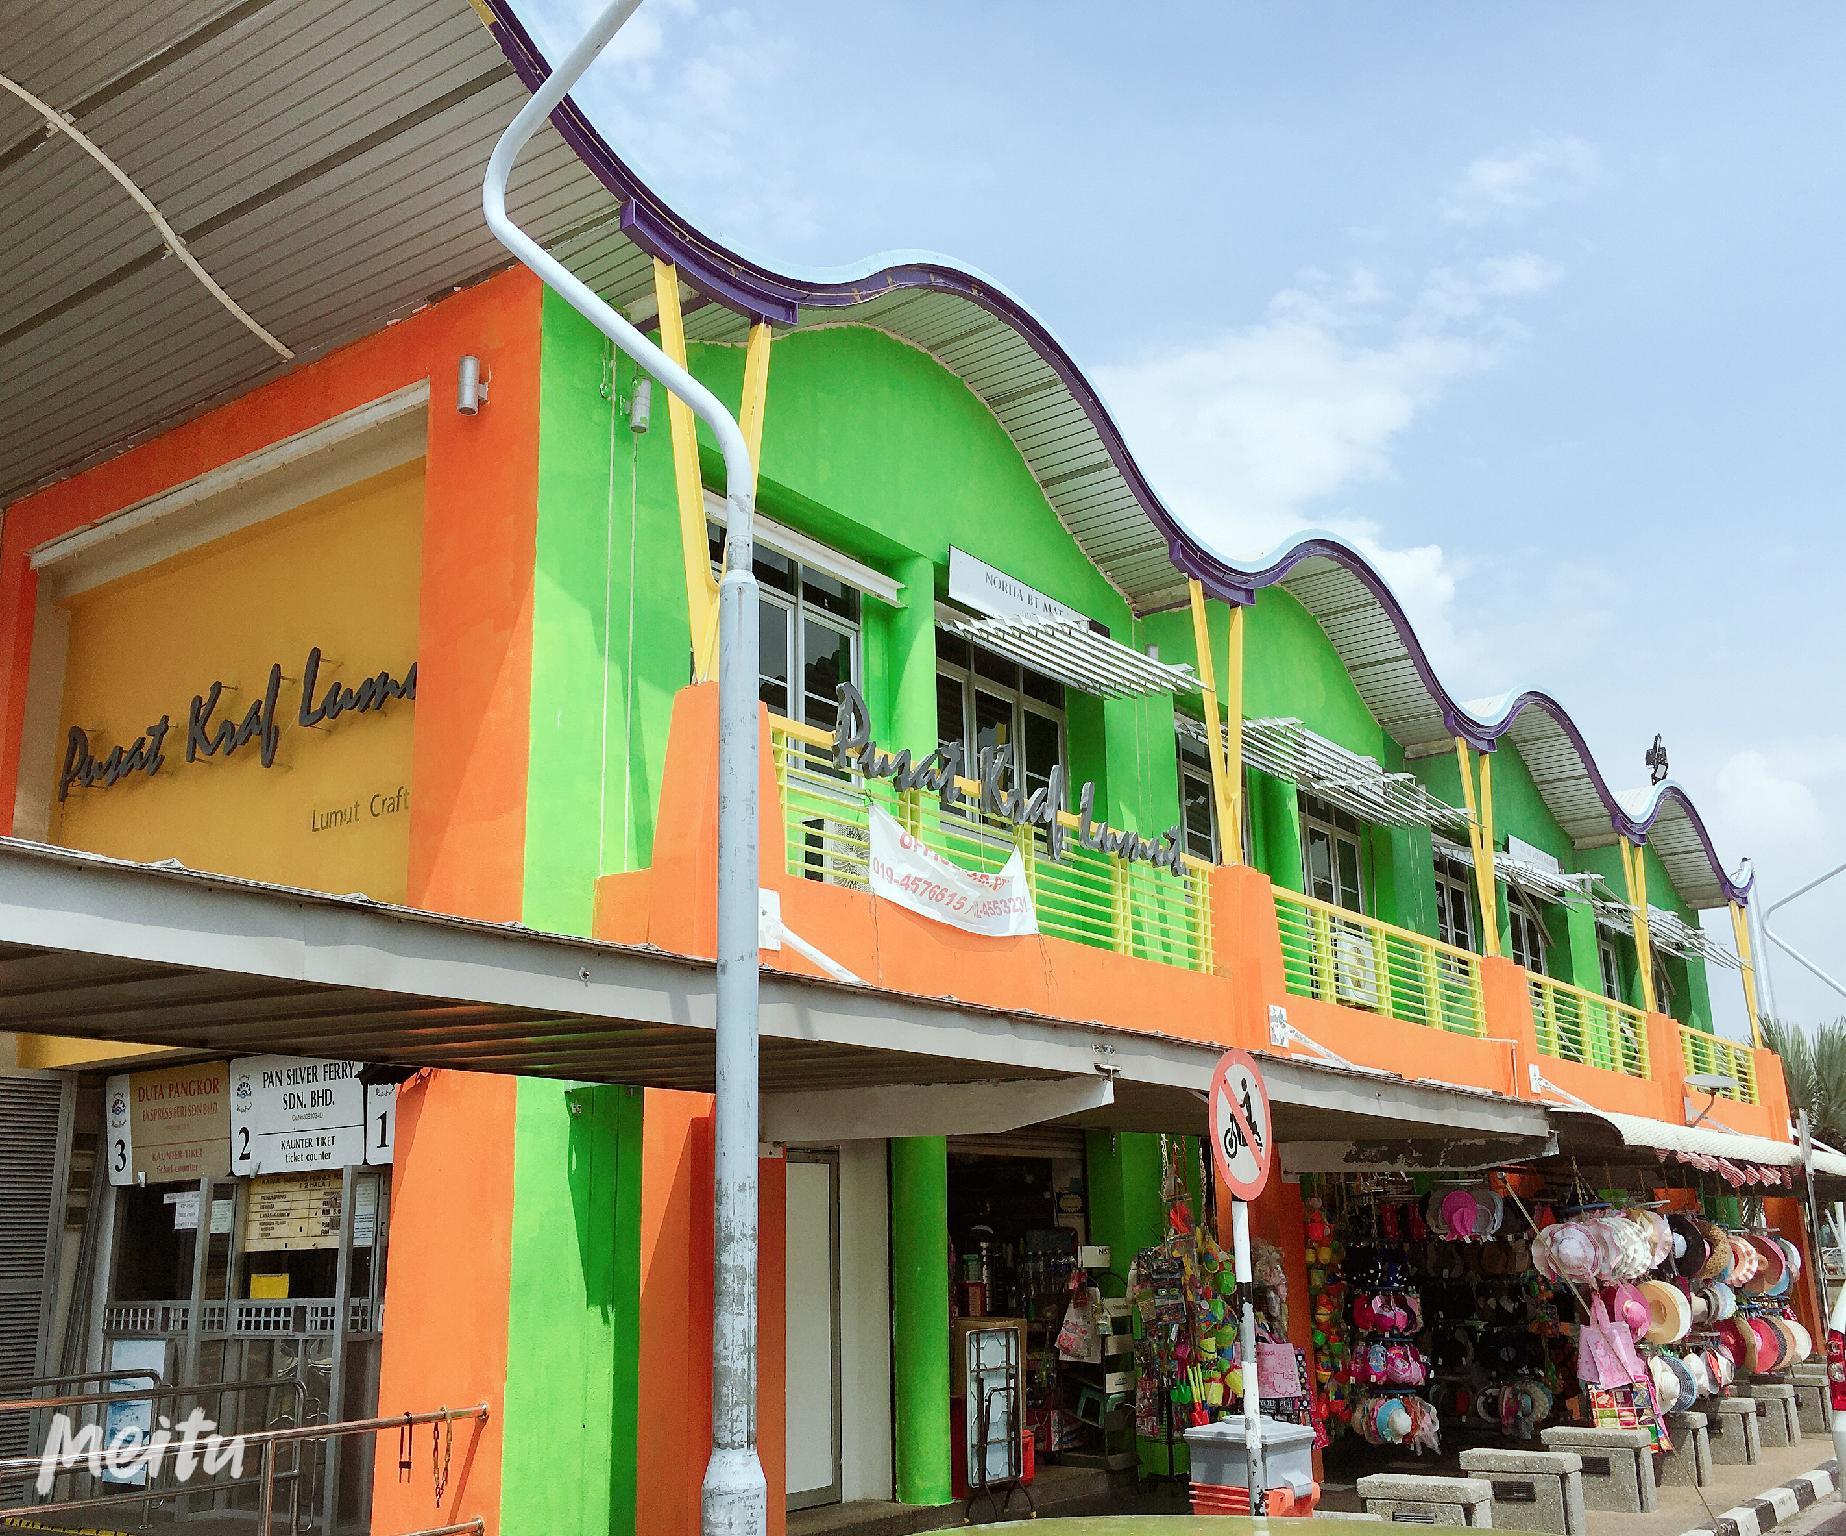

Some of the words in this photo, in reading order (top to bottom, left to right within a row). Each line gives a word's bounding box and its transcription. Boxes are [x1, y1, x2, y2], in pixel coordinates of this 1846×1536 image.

[58, 715, 170, 802] Pusat
[186, 663, 281, 768] Kraf
[832, 682, 963, 804] Pusat
[979, 742, 1065, 861] Kraf
[1079, 781, 1190, 877] Lumut
[311, 800, 360, 832] Lumut
[369, 785, 410, 817] Craft
[138, 1084, 165, 1102] DUTA
[168, 1077, 220, 1099] PANGKOR
[262, 1070, 283, 1089] PAN
[286, 1064, 318, 1086] SILVER
[323, 1060, 355, 1082] FERRY
[283, 1091, 306, 1111] SDN.
[310, 1088, 335, 1109] BHD.
[238, 1126, 251, 1161] 2
[281, 1138, 313, 1151] KAUNTER
[315, 1135, 336, 1148] TIKET
[375, 1110, 390, 1149] 1
[114, 1138, 127, 1173] 3
[285, 1152, 304, 1164] ticket
[305, 1151, 332, 1162] counter
